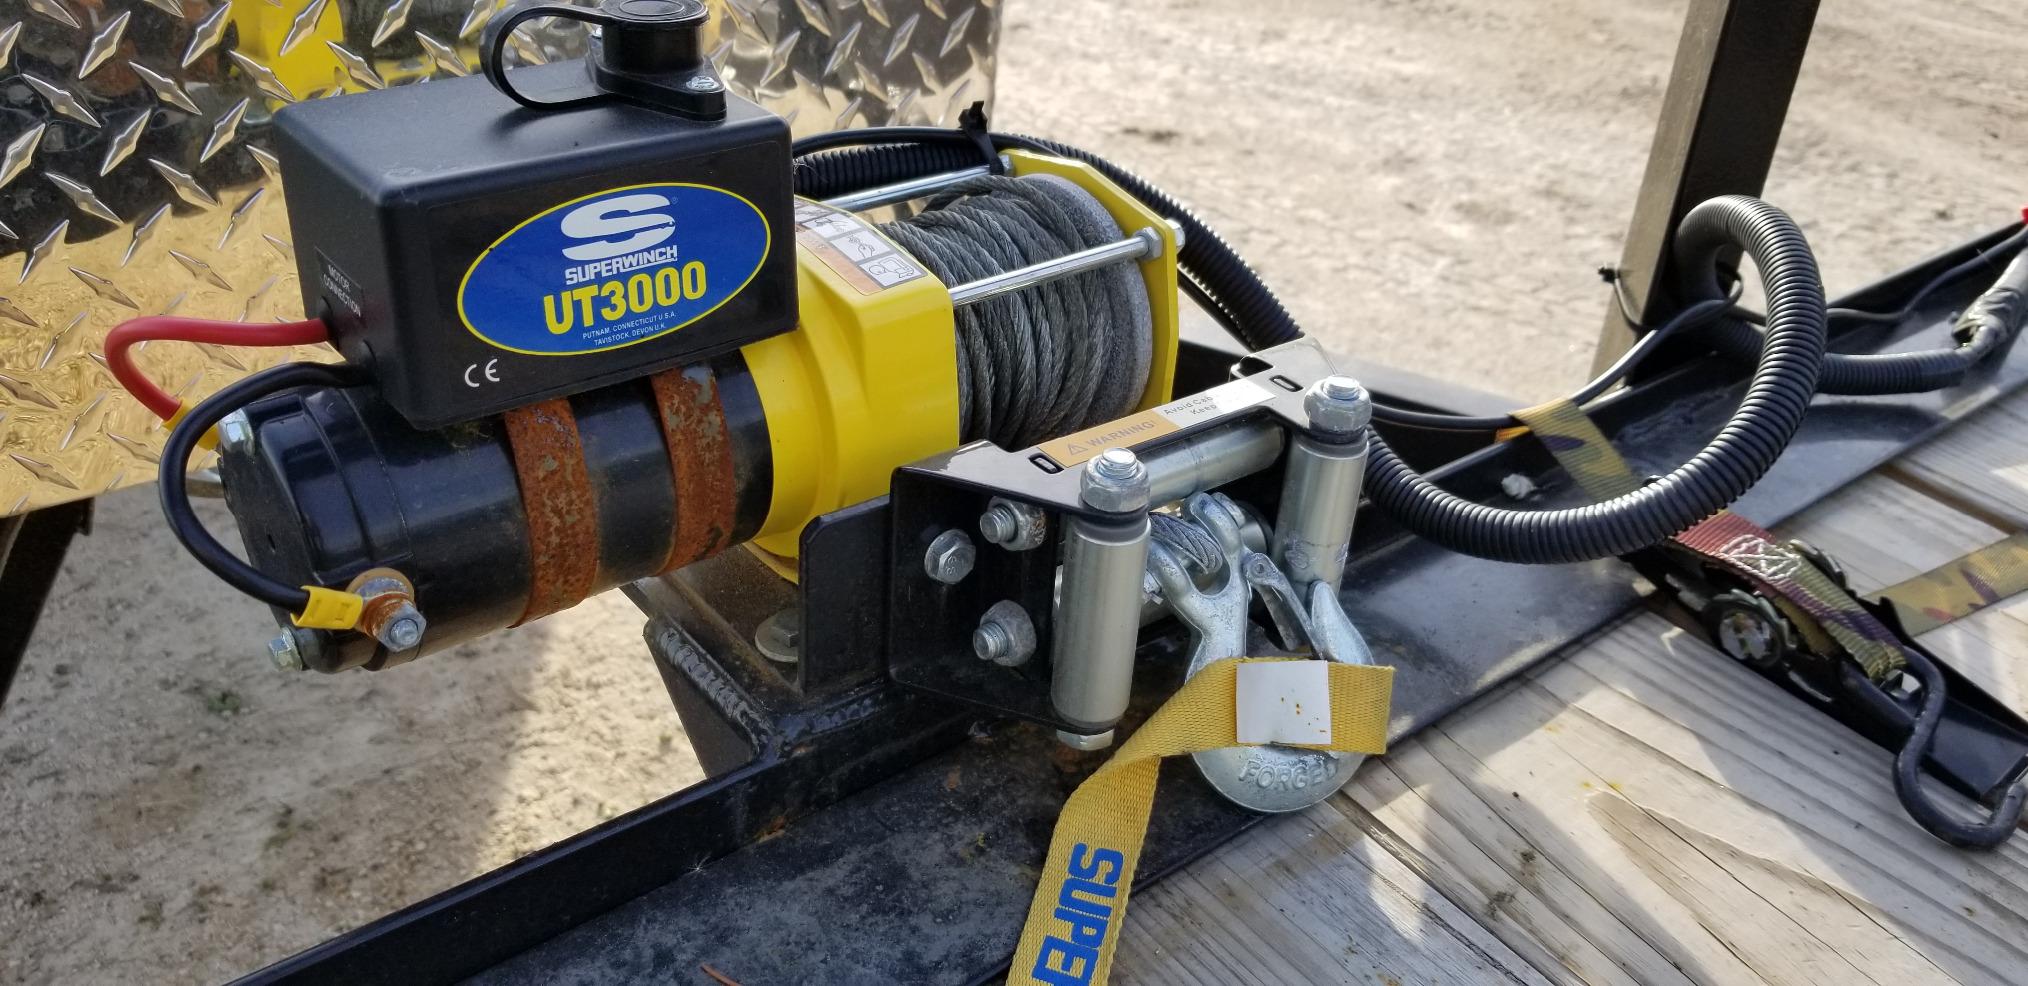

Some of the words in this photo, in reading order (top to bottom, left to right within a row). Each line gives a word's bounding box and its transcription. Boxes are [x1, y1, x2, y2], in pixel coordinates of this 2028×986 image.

[328, 264, 350, 292] MOTOR
[565, 245, 678, 285] SUPERWINCH
[323, 273, 361, 317] CONNECTION
[543, 261, 708, 335] UT3000
[612, 316, 658, 332] CONNECTICUT
[464, 359, 500, 388] CE
[1163, 402, 1194, 415] Avoid
[1190, 404, 1217, 415] Keep
[1239, 759, 1338, 791] FORGED
[1032, 842, 1125, 986] SUPE
